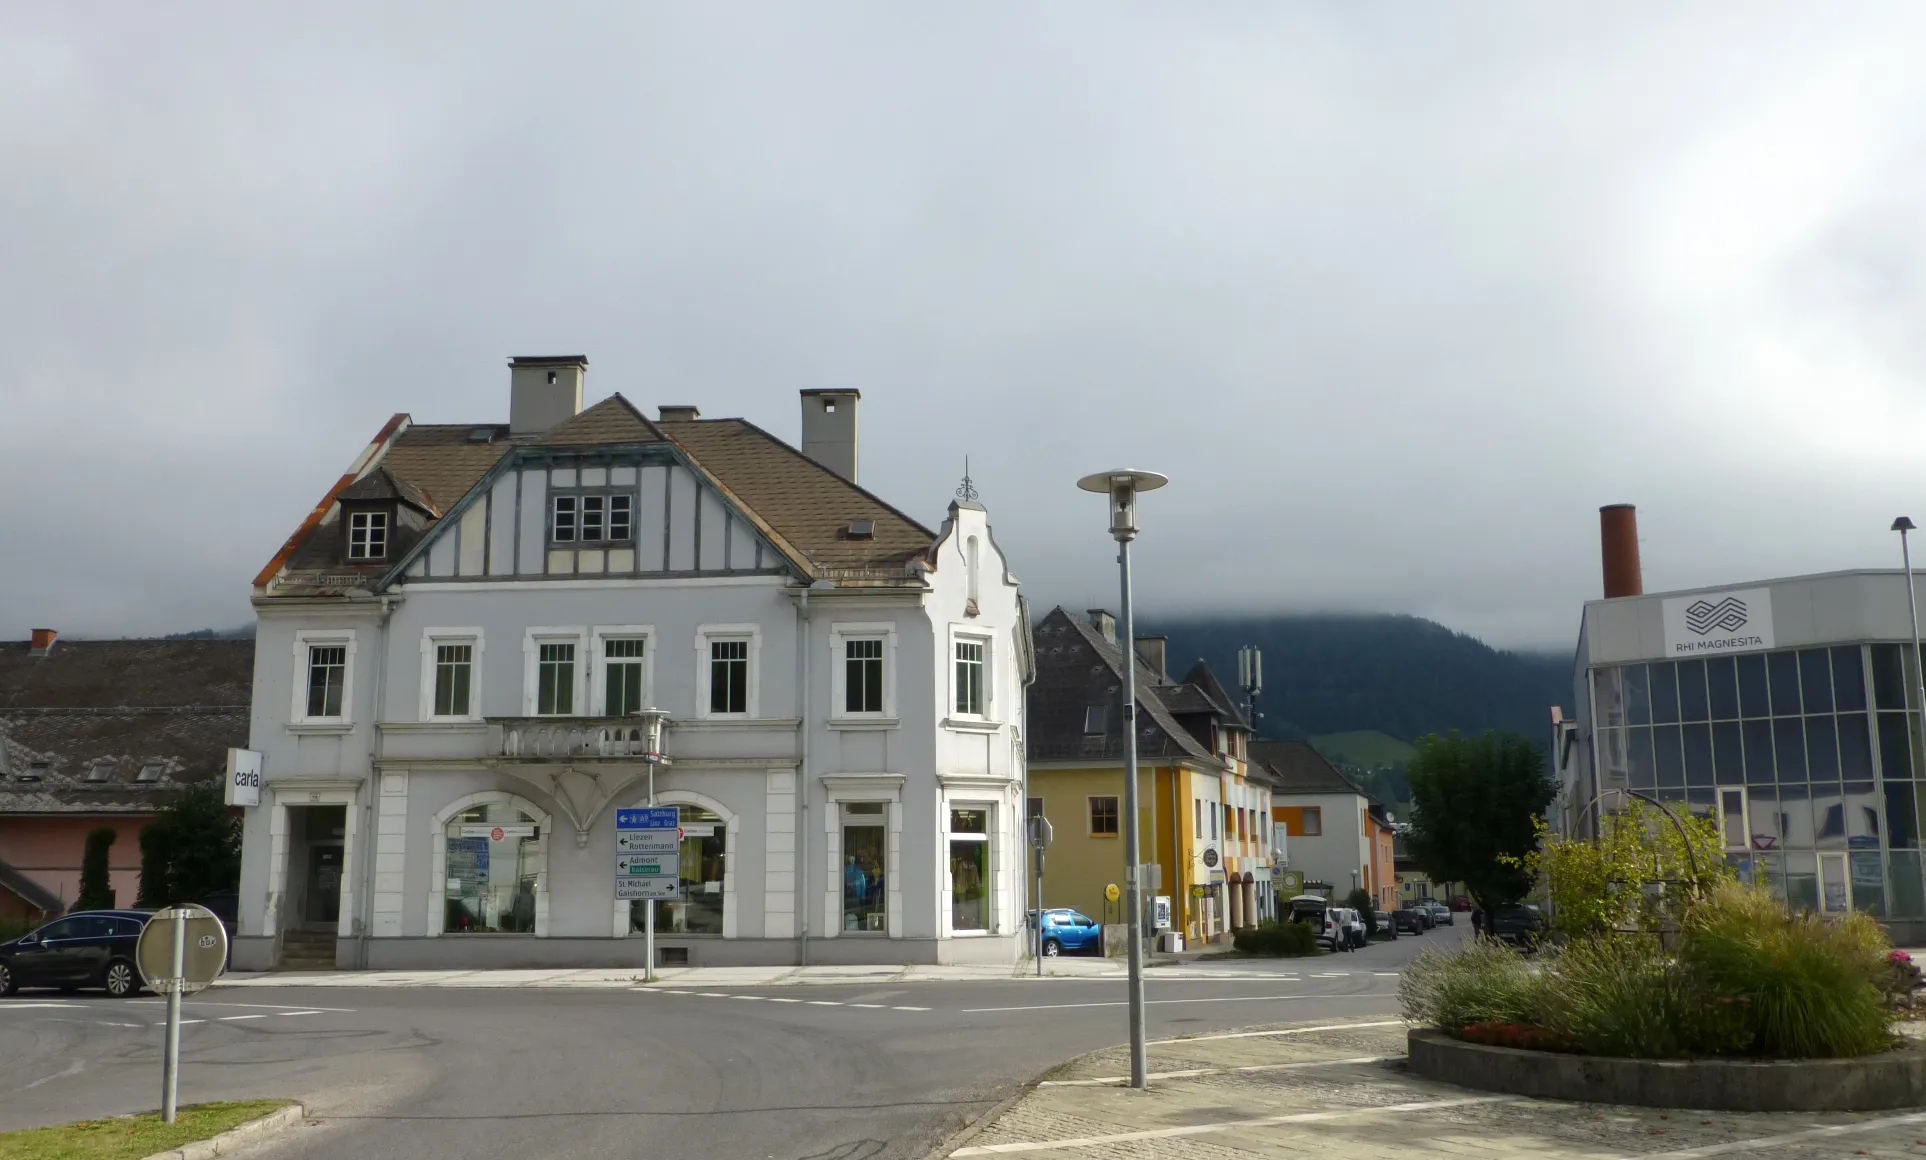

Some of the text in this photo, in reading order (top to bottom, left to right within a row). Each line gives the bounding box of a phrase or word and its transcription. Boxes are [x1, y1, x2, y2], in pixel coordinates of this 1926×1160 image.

[1676, 636, 1762, 652] RHI MAGNESITA
[235, 768, 259, 788] carla
[650, 810, 676, 818] Salzburg
[650, 819, 676, 827] Linz Graz
[630, 856, 658, 864] Admont
[618, 889, 650, 897] Gaishorn
